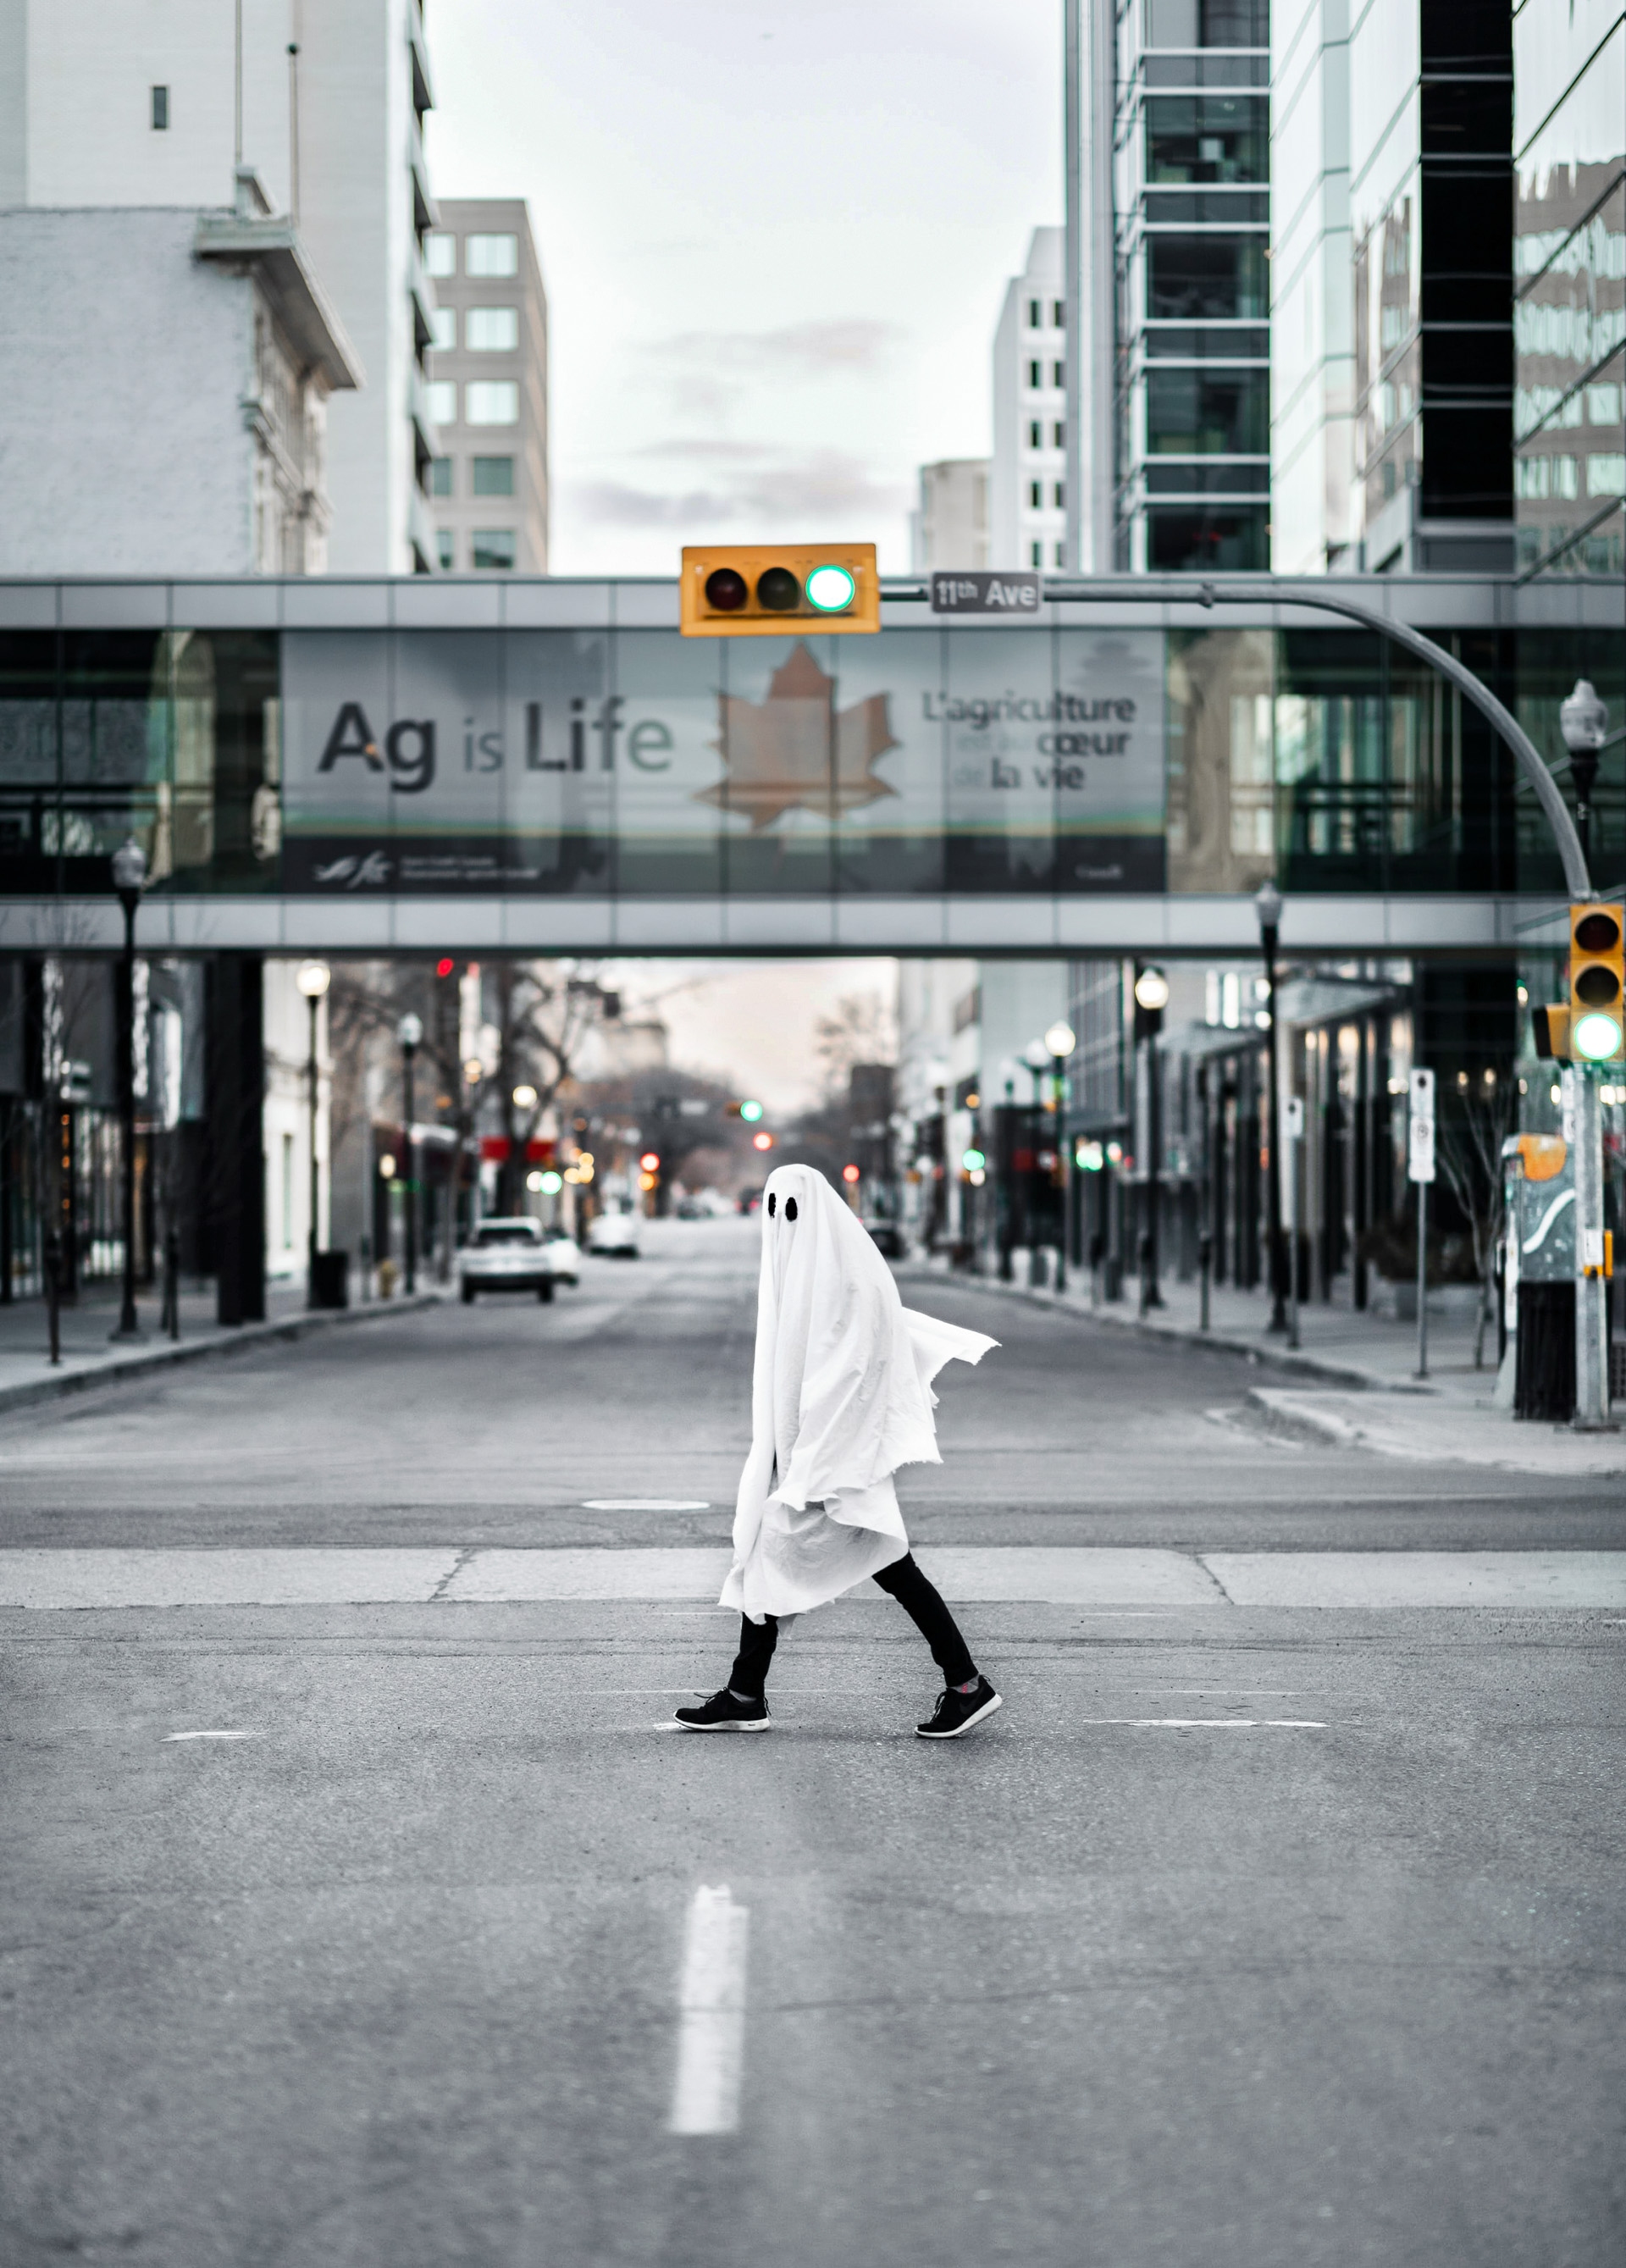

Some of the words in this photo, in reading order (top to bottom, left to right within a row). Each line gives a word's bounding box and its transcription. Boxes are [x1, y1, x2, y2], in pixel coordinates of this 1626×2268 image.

[936, 579, 978, 606] 11th
[985, 579, 1037, 606] Ave
[921, 690, 1137, 730] L'agriculture
[318, 701, 437, 793] Ag
[463, 717, 505, 772] is
[526, 695, 674, 772] Life
[991, 757, 1021, 789] la
[1034, 759, 1085, 790] vie
